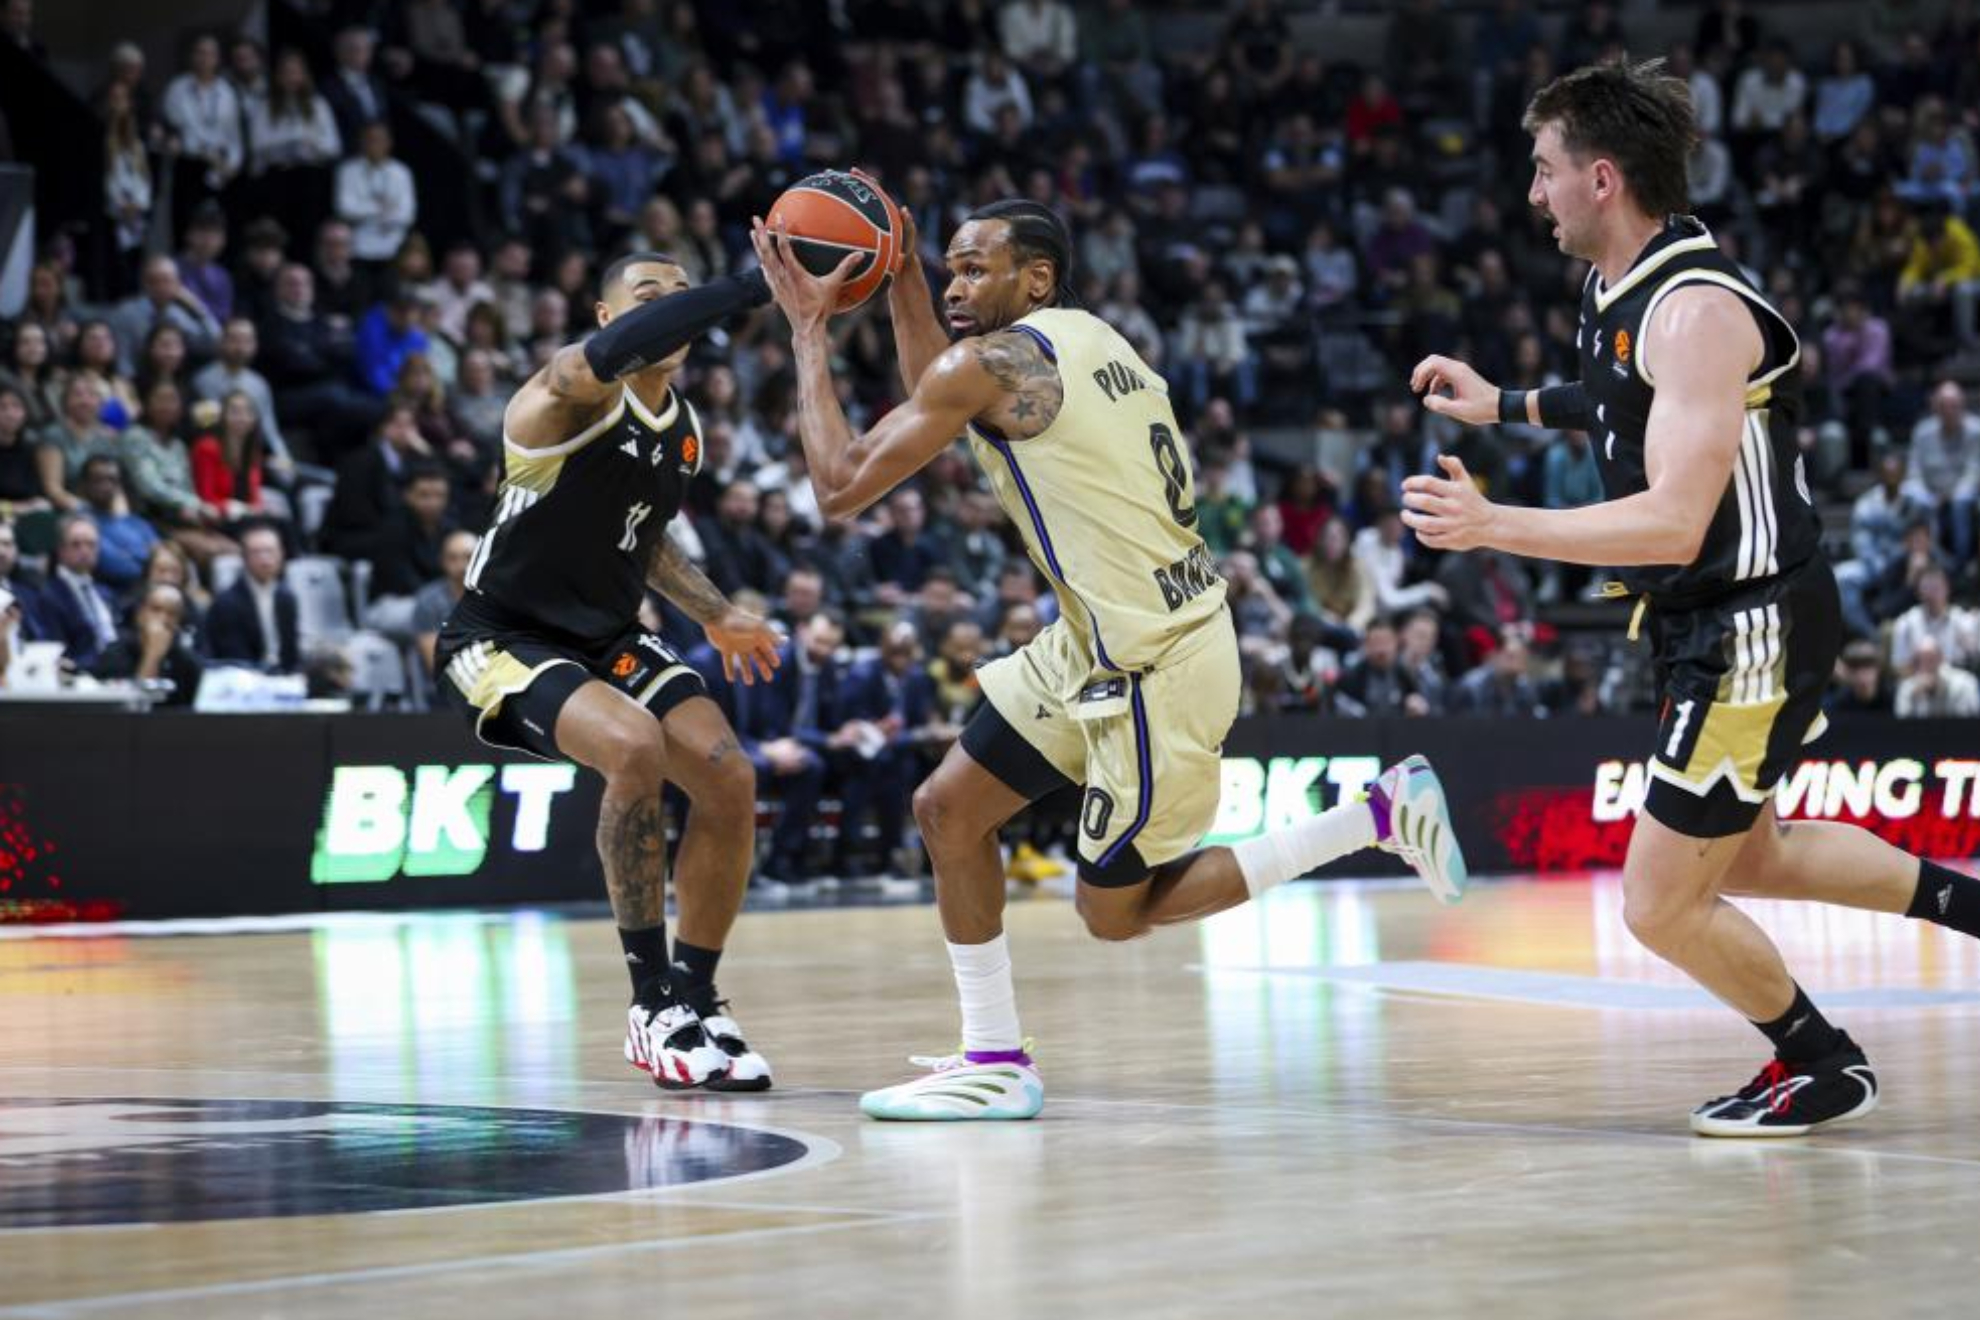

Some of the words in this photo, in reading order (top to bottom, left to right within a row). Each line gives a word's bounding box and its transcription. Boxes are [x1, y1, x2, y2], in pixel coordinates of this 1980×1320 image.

[1148, 422, 1197, 528] 0
[1665, 700, 1696, 759] 1
[312, 763, 577, 882] BKT
[1084, 787, 1114, 840] 0
[1206, 756, 1381, 840] BKT
[1775, 758, 1924, 820] VING
